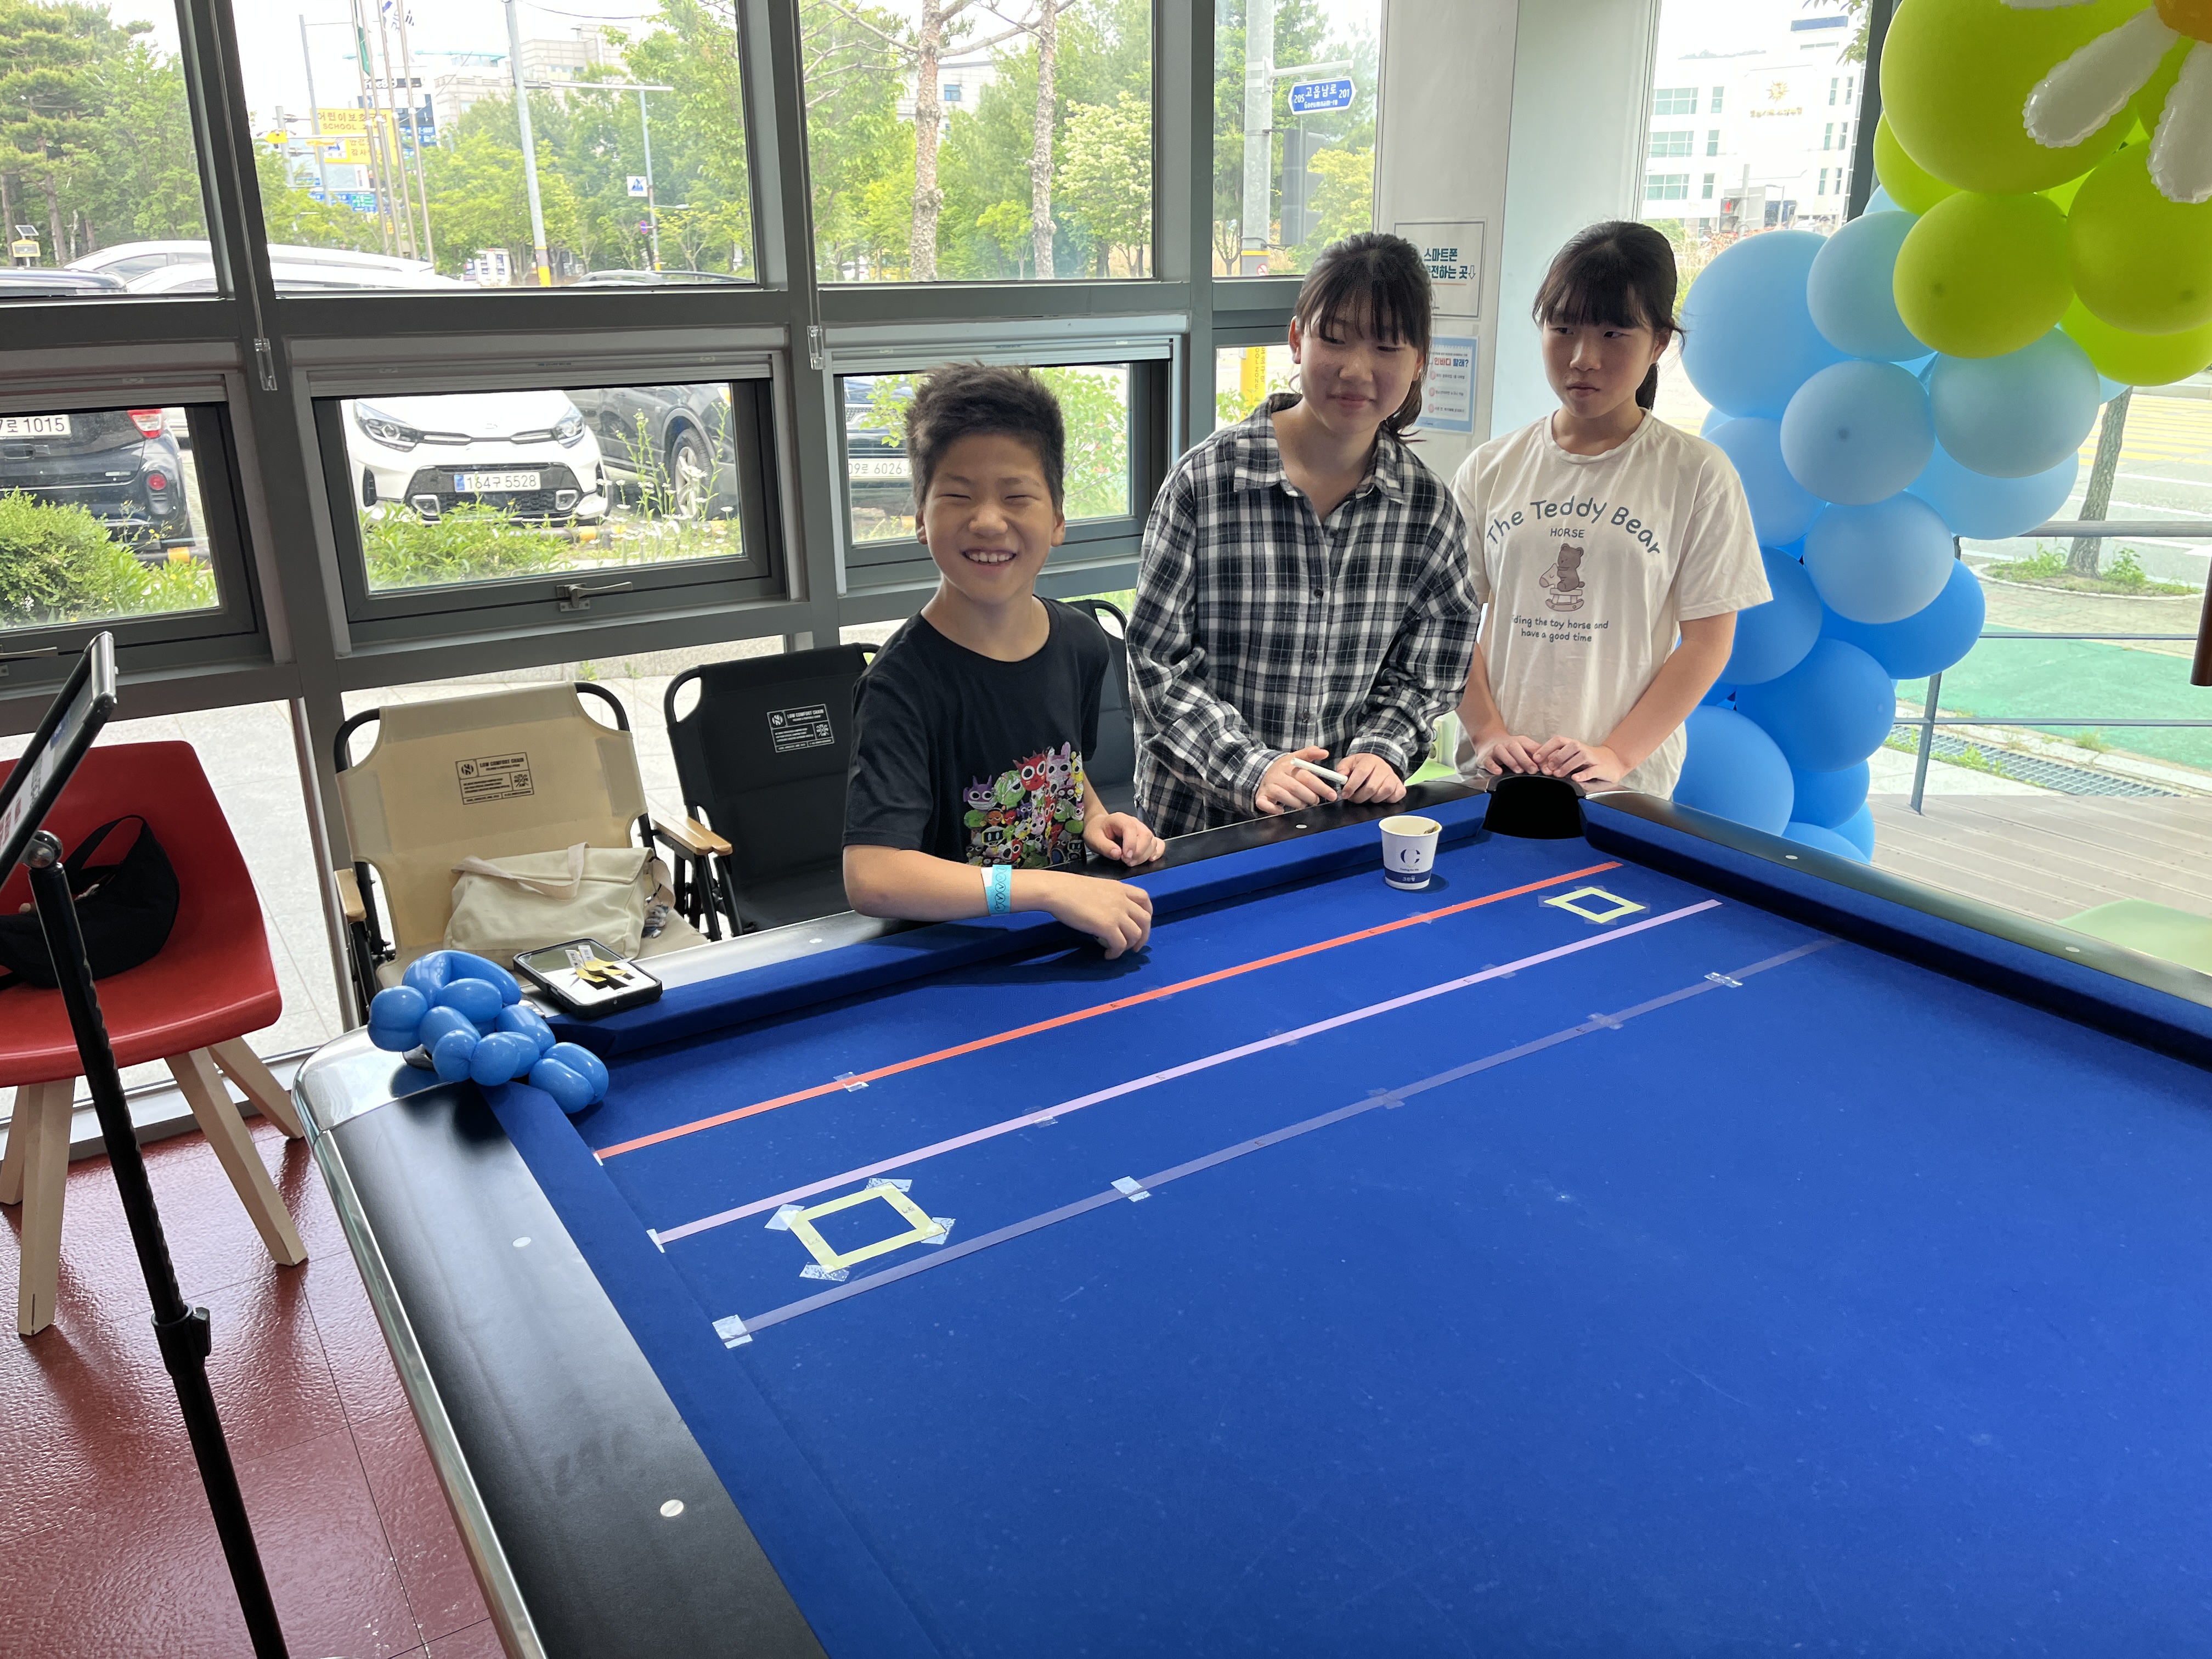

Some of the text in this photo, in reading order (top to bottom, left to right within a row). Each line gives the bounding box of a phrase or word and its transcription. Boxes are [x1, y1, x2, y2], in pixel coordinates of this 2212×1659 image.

[1294, 84, 1350, 103] 205 고읍남로 201
[1304, 99, 1338, 109] Goeumnam-ro
[1424, 248, 1458, 262] 스마트폰
[1459, 266, 1468, 279] 곳
[1434, 357, 1451, 366] 인바디
[23, 417, 65, 433] 1015
[874, 462, 902, 475] 6026
[505, 475, 537, 488] 5528
[1486, 495, 1660, 554] The Teddy Bear
[1550, 527, 1585, 538] HORSE
[1535, 617, 1548, 626] the
[1550, 619, 1565, 631] toy
[1567, 619, 1591, 629] horse
[1594, 620, 1609, 629] and
[1521, 628, 1539, 637] have
[1549, 631, 1570, 643] good
[1573, 633, 1592, 642] time
